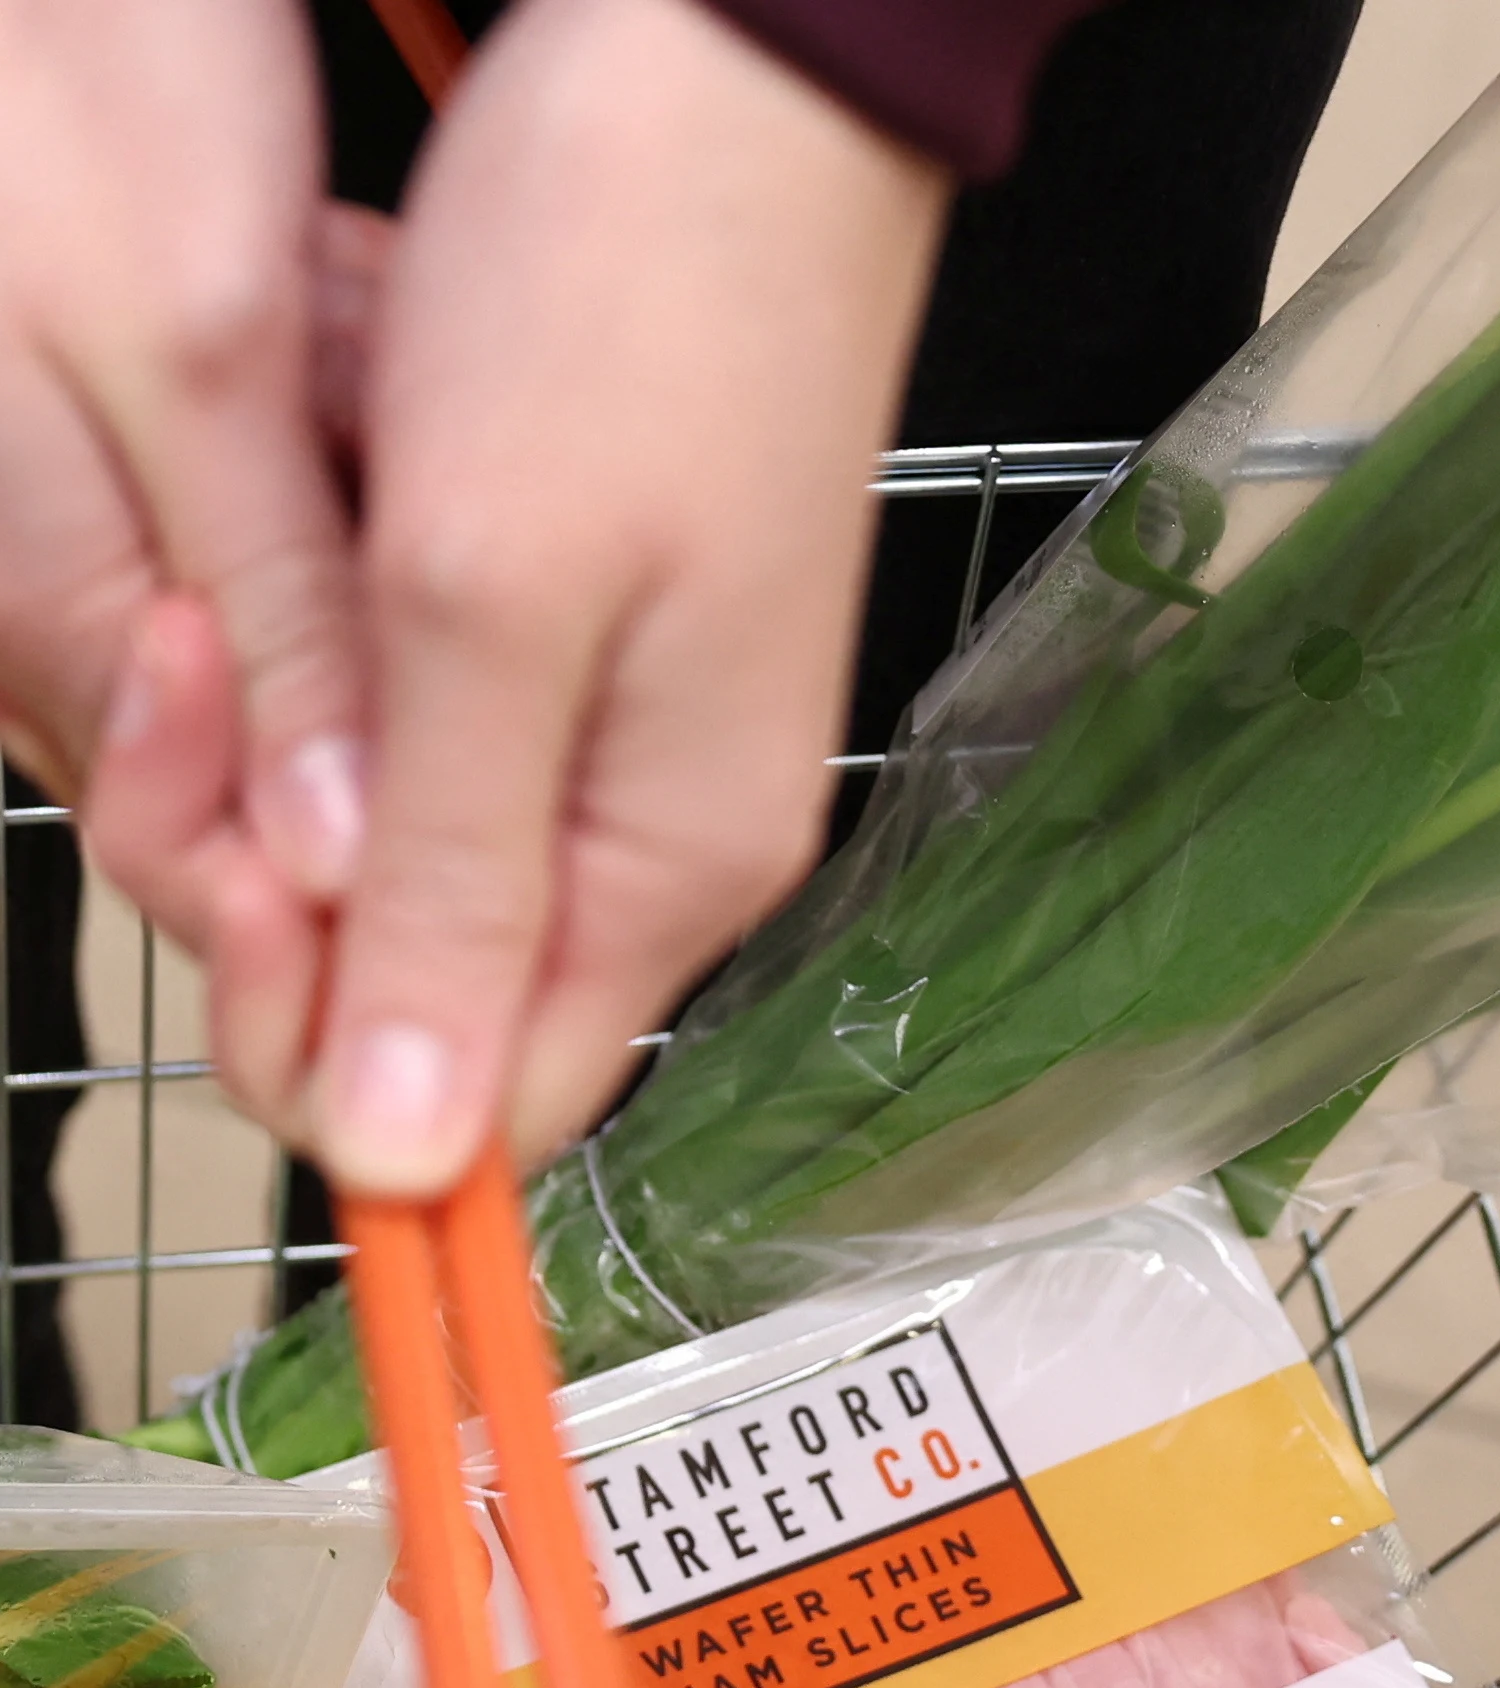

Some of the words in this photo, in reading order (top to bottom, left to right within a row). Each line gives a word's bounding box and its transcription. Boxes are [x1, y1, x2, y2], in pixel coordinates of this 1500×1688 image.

[586, 1366, 929, 1531] TAMFORD
[589, 1470, 847, 1610] TREET
[873, 1429, 980, 1499] CO.
[640, 1591, 830, 1678] WAFER
[848, 1530, 978, 1599] THIN
[807, 1576, 992, 1668] SLICES
